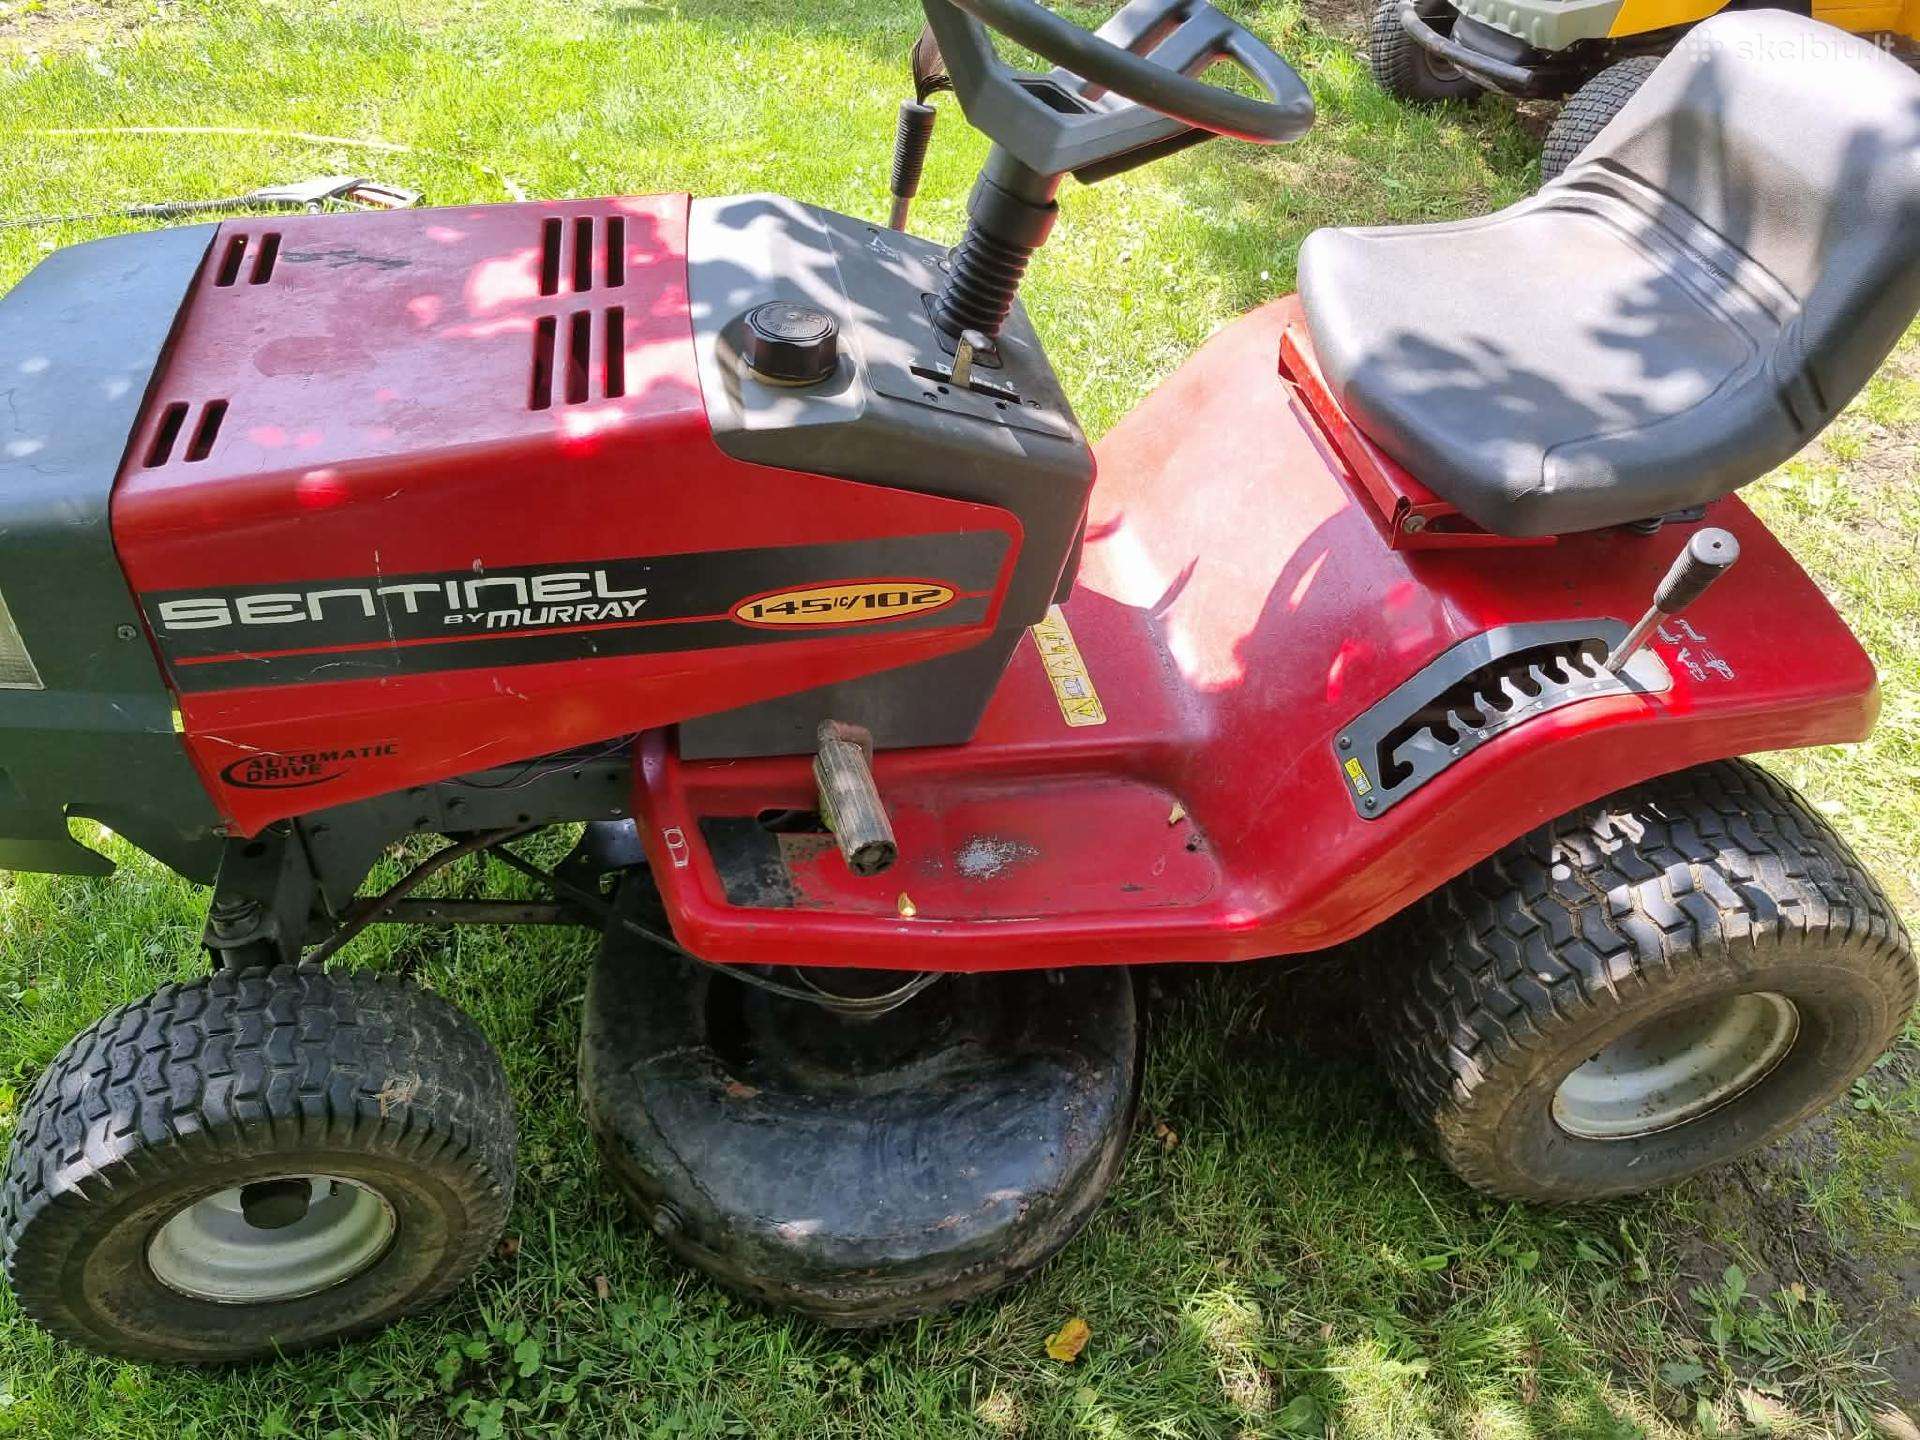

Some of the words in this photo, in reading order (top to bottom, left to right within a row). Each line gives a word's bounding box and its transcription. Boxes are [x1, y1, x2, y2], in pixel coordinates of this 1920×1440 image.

[158, 570, 648, 630] SENTINEL
[443, 612, 485, 625] BY
[486, 599, 647, 629] MURRAY
[249, 744, 395, 769] AUTOMATIC
[246, 764, 322, 783] DRIVE
